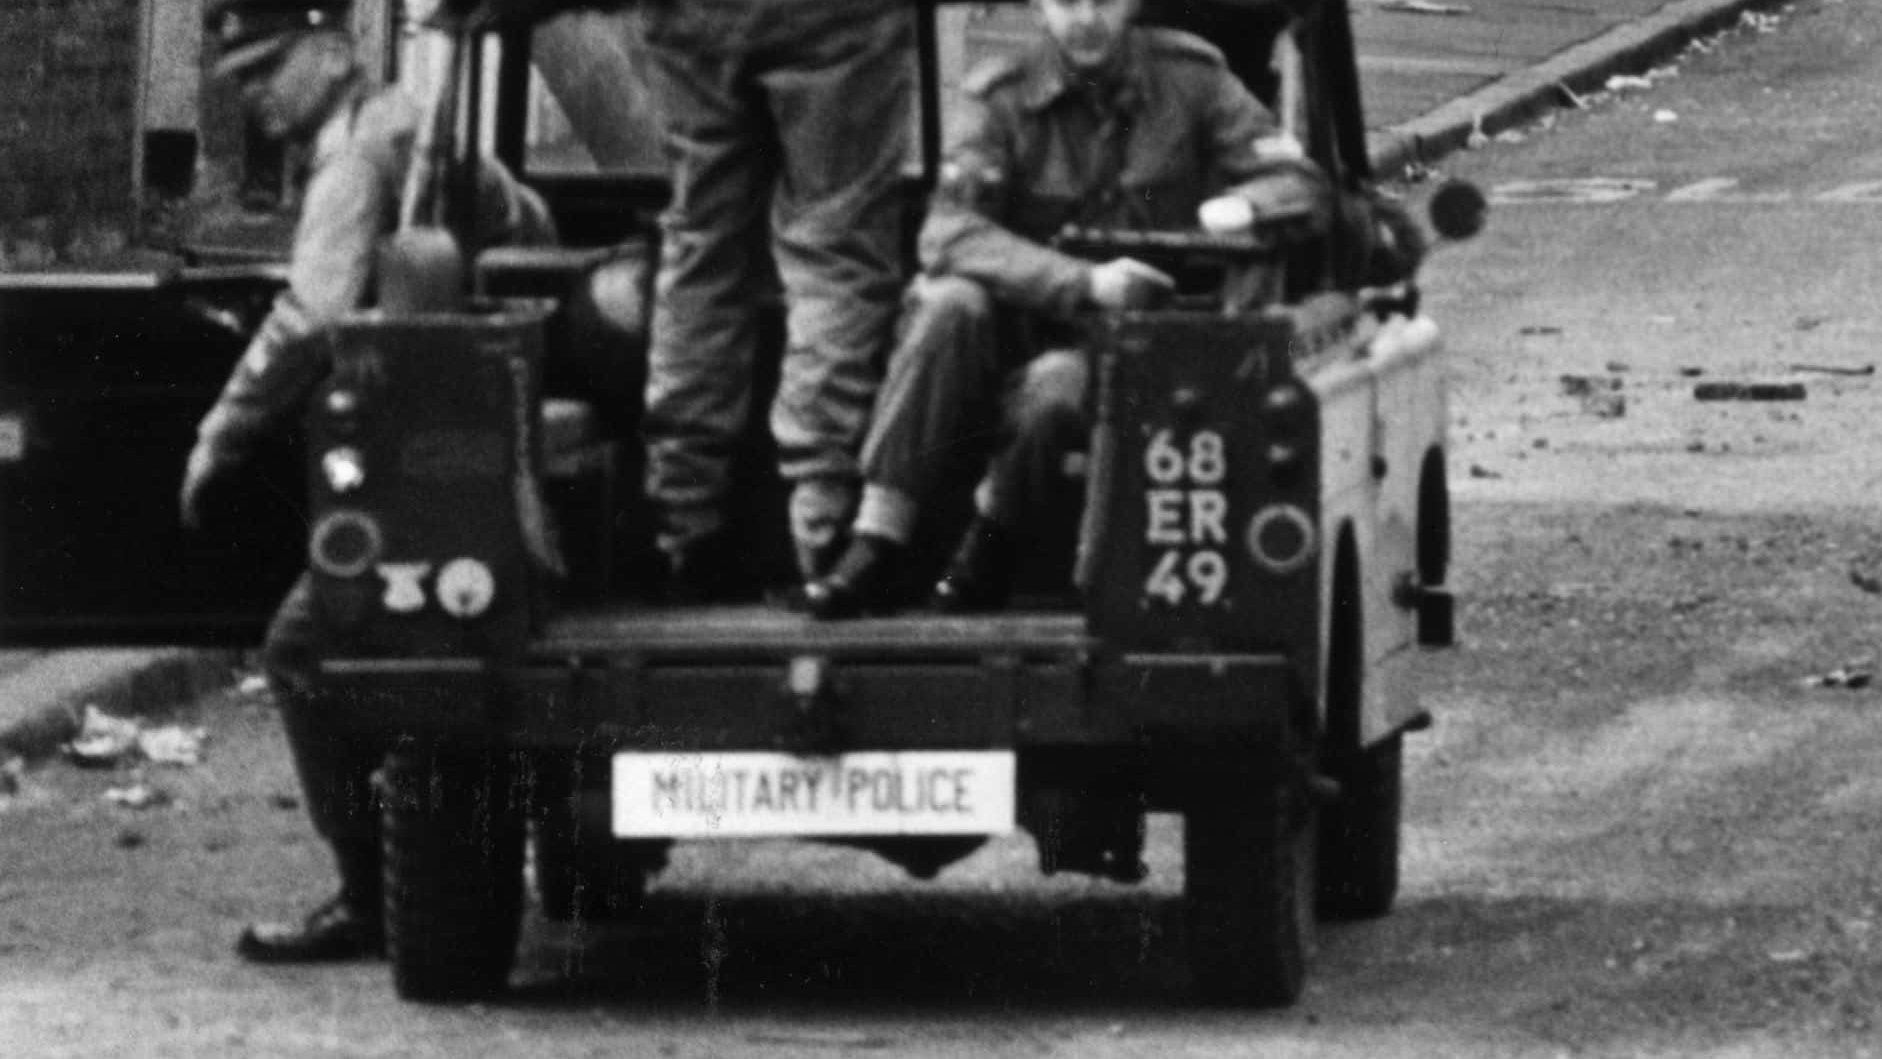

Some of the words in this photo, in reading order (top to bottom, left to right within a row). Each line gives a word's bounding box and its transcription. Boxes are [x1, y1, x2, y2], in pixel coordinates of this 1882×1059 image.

[1145, 431, 1227, 482] 68
[1145, 491, 1229, 546] ER
[1145, 551, 1228, 606] 49
[652, 768, 821, 814] MILITARY
[847, 766, 974, 814] POLICE
